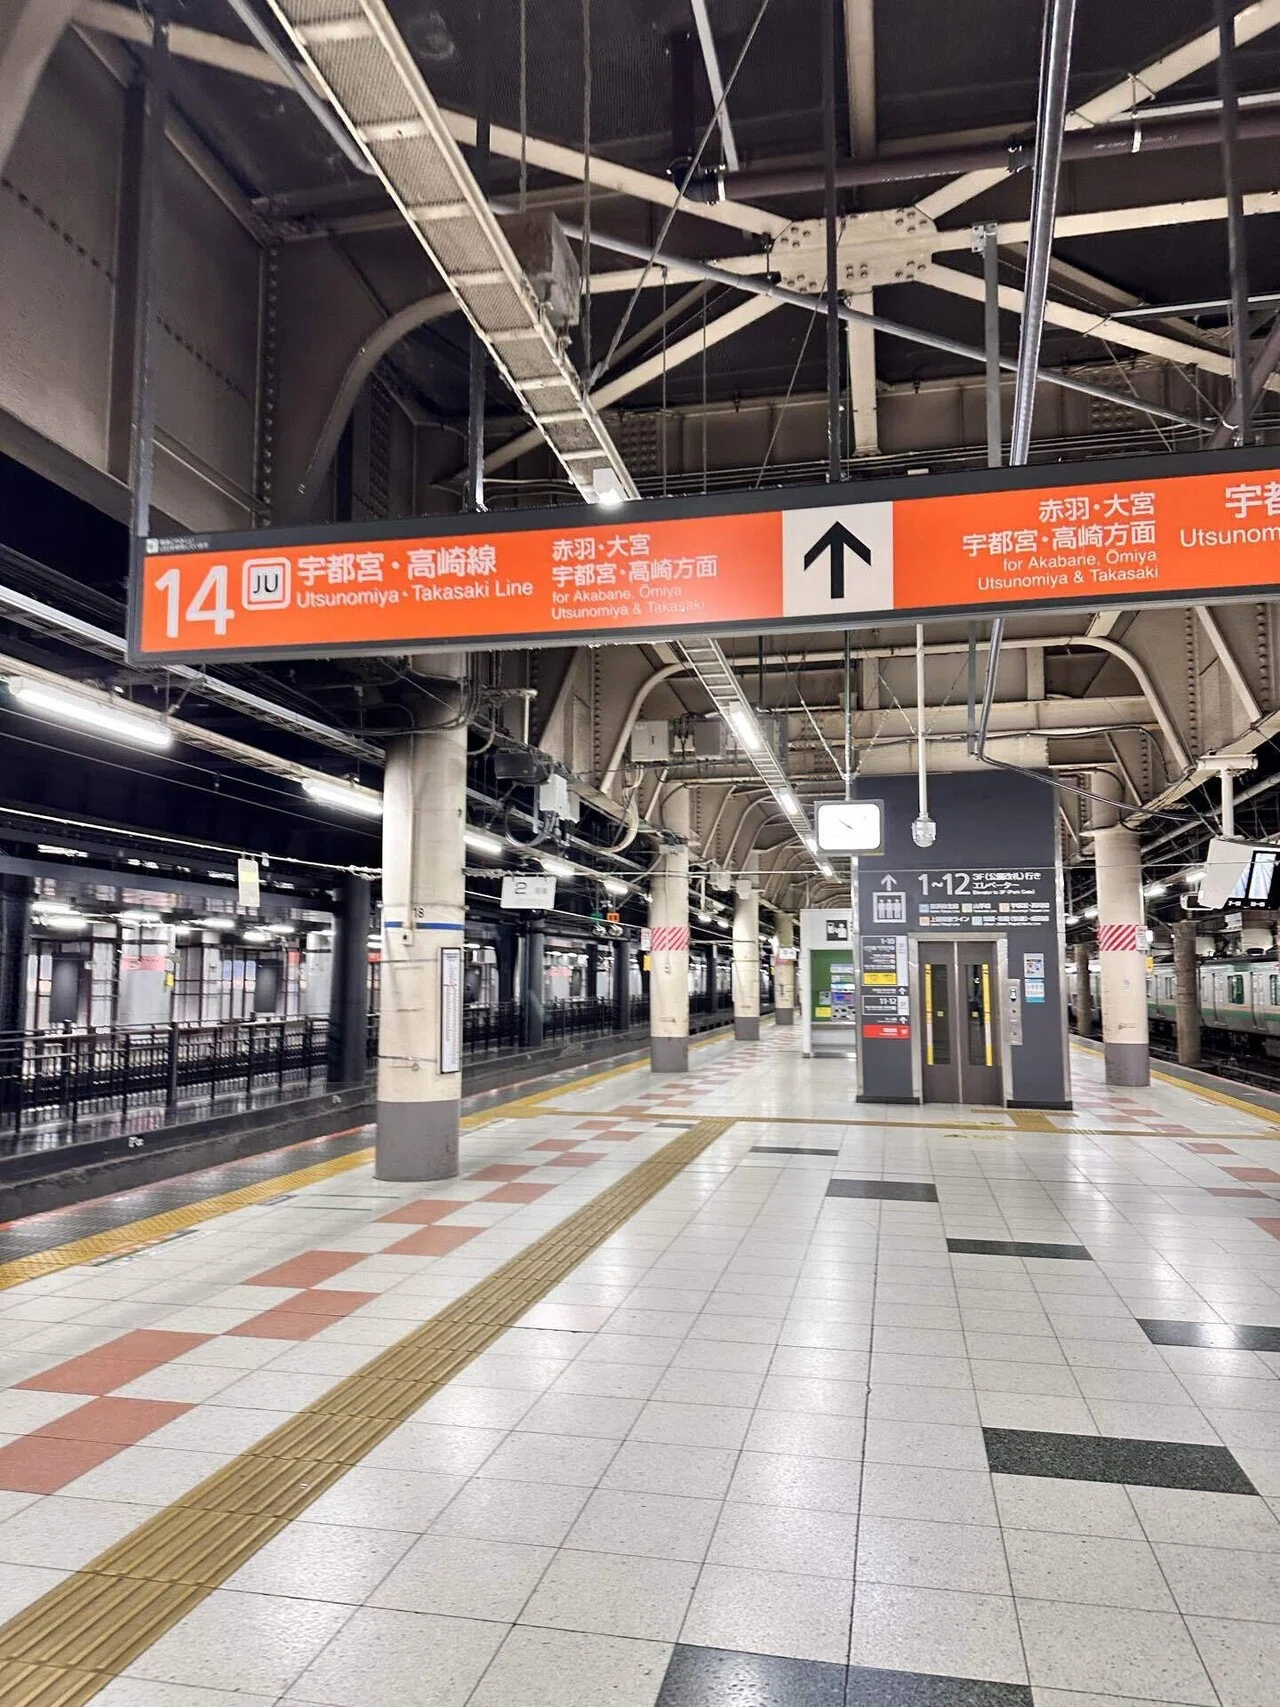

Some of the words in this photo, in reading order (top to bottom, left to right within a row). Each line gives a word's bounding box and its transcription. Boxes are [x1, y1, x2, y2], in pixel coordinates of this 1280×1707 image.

[1003, 559, 1022, 572] for
[252, 573, 279, 594] JU
[977, 572, 1068, 591] Utsunomiya
[1073, 570, 1085, 584] &
[1089, 565, 1159, 583] Takasaki
[495, 579, 534, 597] Line
[552, 591, 570, 604] for
[154, 564, 236, 639] 14
[551, 606, 629, 620] Utsunomiya
[632, 602, 642, 615] &
[648, 599, 705, 613] Takasaki
[515, 882, 527, 895] 2
